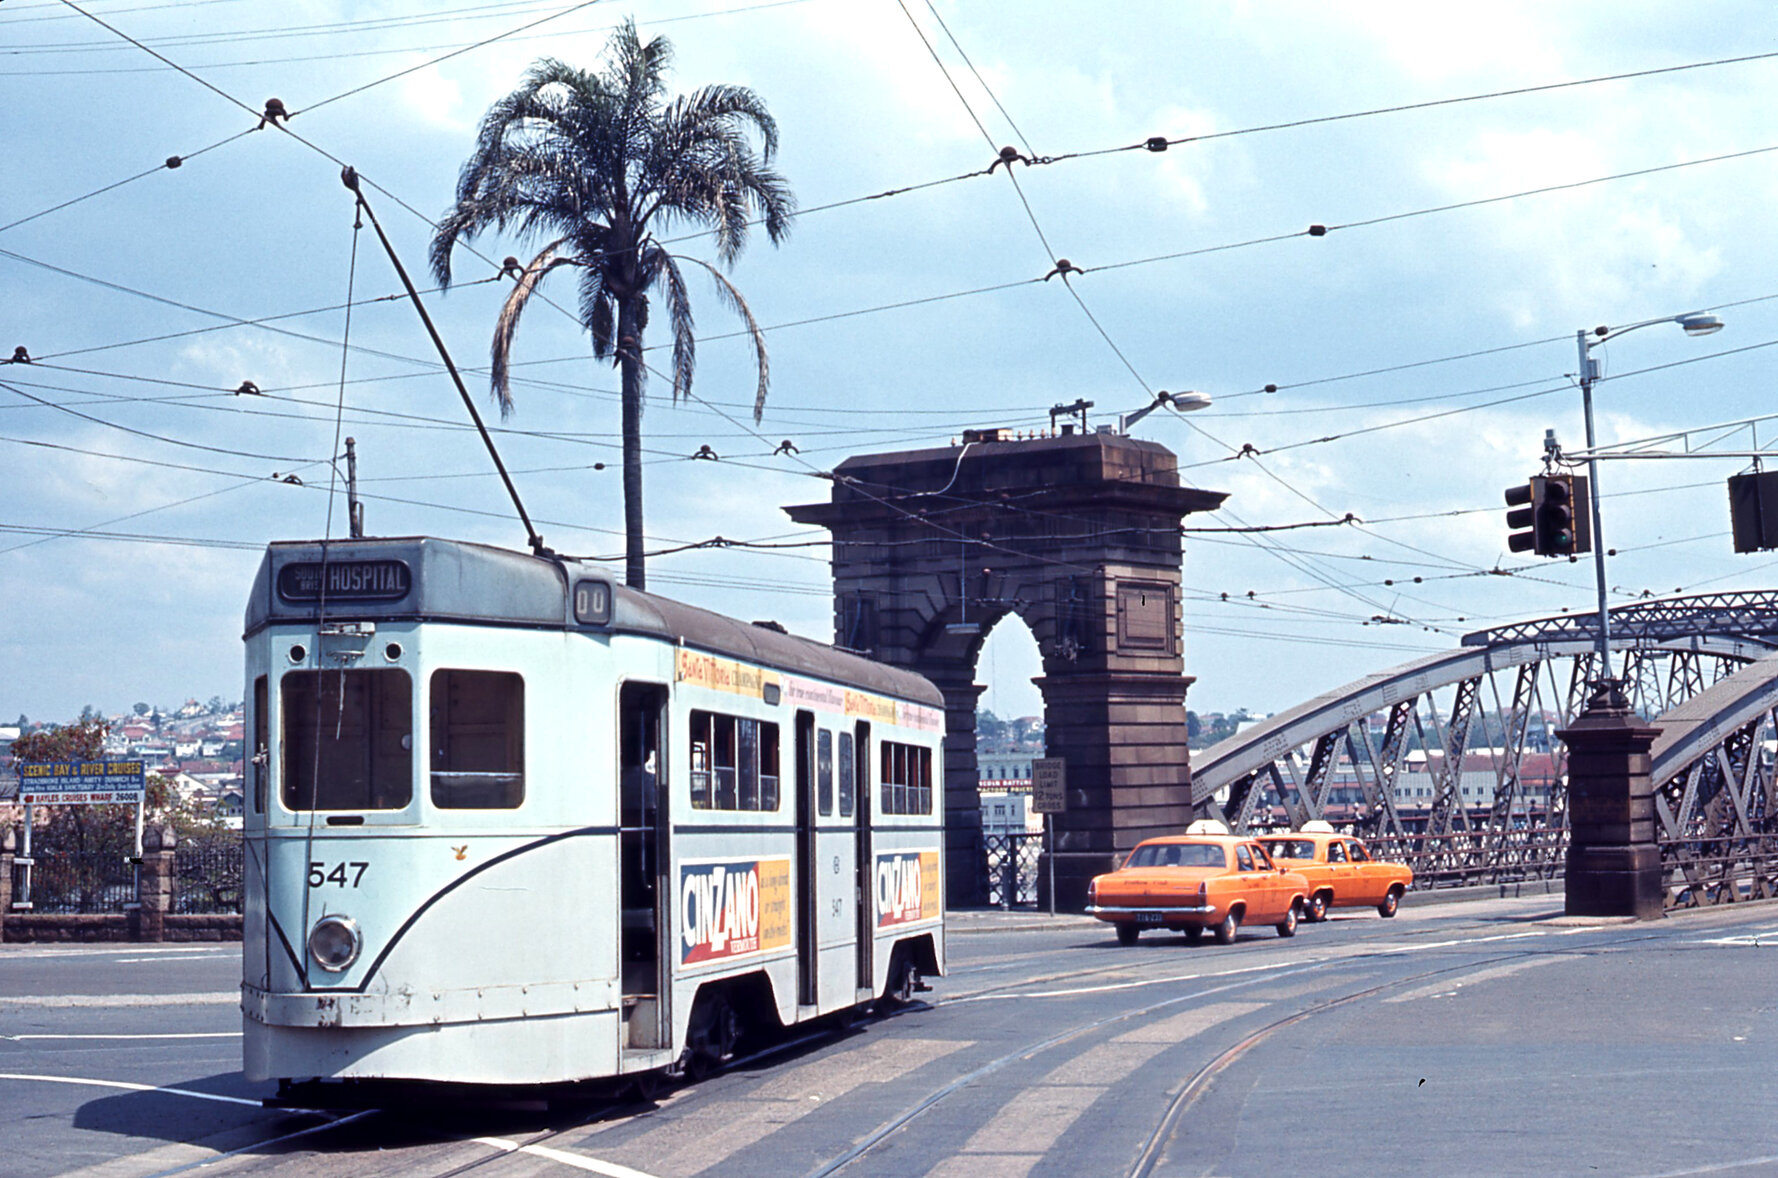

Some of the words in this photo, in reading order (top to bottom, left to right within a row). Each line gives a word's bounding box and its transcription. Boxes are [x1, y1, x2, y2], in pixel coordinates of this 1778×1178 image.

[330, 564, 406, 591] HOSPITAL
[23, 764, 51, 777] SCENIC
[54, 764, 70, 776] BAY
[81, 763, 104, 776] RIVER
[107, 762, 141, 775] CRUISES
[1039, 771, 1058, 780] LOAD
[1039, 781, 1058, 789] LIMIT
[62, 793, 88, 802] CRUISES
[90, 793, 113, 801] WHARF
[1037, 802, 1061, 810] GROSS
[308, 862, 370, 888] 547
[877, 855, 921, 919] CINZANO
[682, 866, 759, 952] CINZANO
